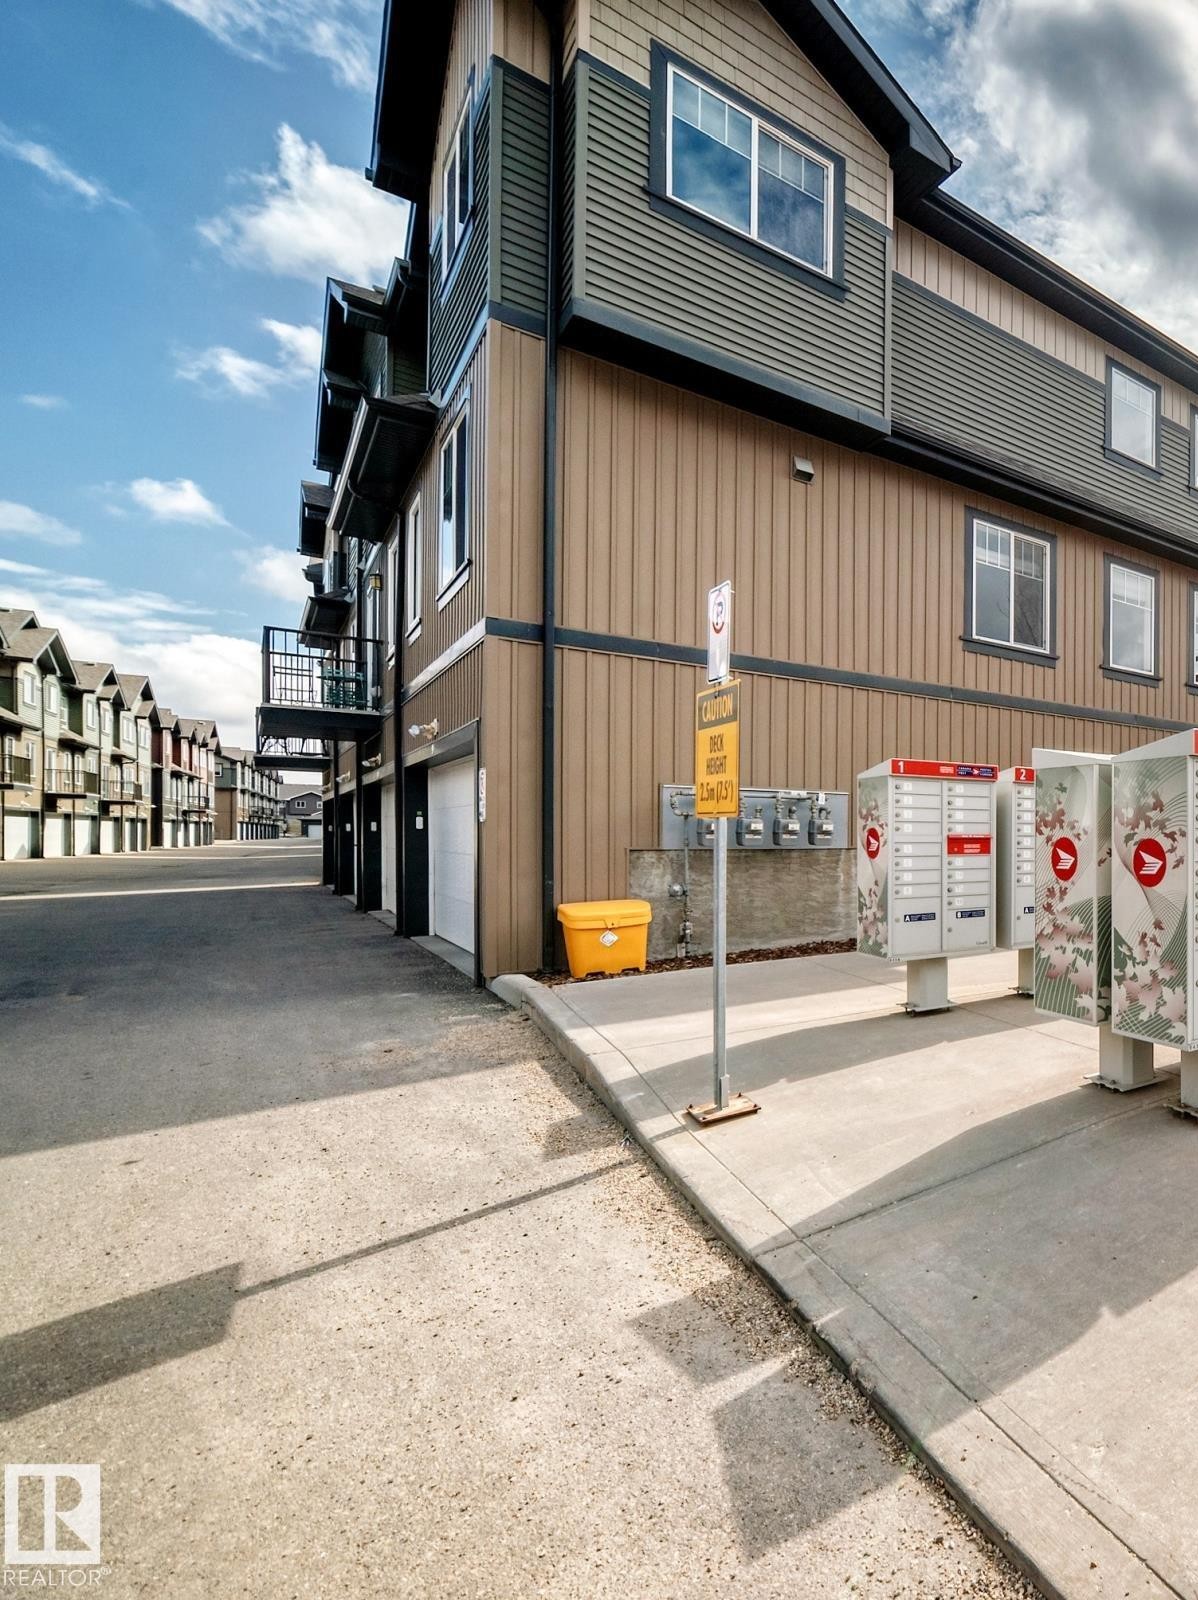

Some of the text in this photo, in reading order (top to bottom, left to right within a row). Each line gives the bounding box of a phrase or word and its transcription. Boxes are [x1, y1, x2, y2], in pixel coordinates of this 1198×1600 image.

[702, 692, 733, 722] CAUTION
[709, 733, 724, 754] DECK
[706, 755, 727, 775] HEIGHT
[898, 761, 904, 774] 1
[1019, 769, 1026, 781] 2
[700, 782, 715, 802] 2.5m
